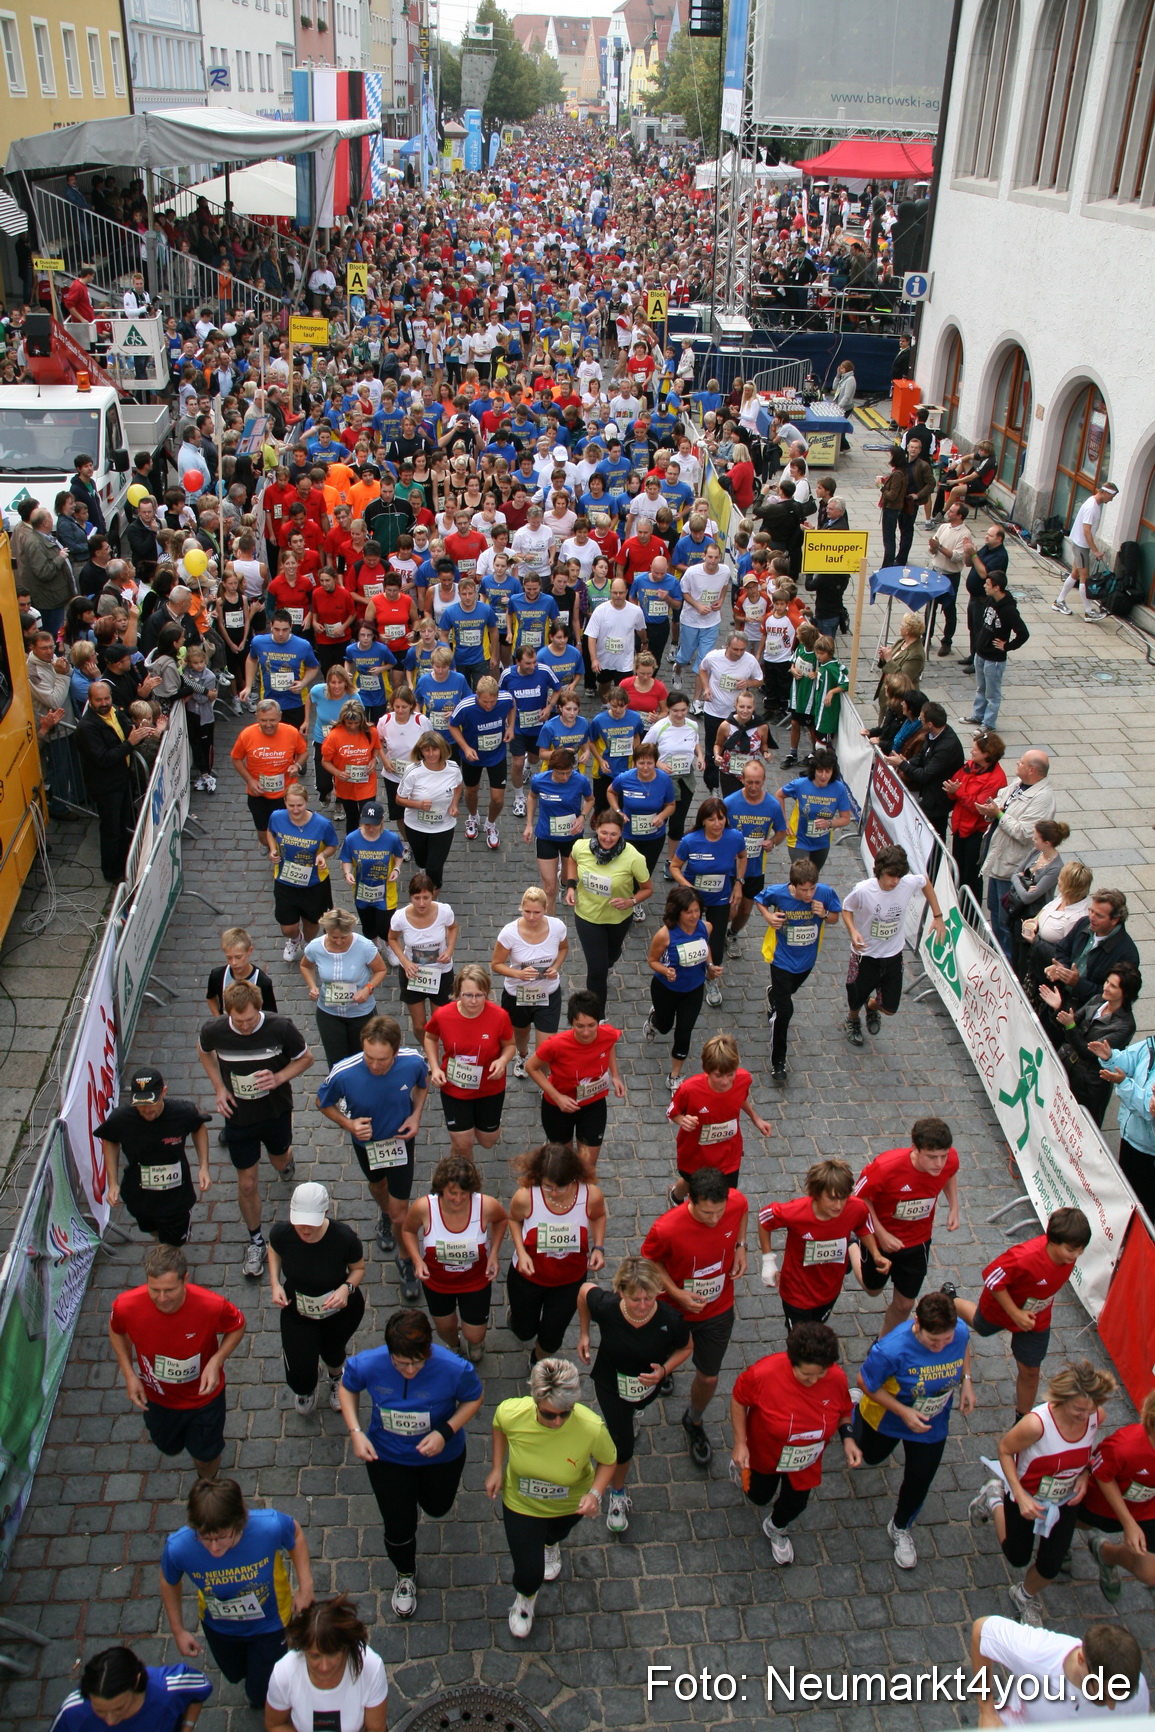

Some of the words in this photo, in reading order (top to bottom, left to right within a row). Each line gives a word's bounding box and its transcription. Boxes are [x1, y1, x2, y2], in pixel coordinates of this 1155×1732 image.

[351, 272, 363, 288] A
[652, 300, 664, 315] A
[292, 323, 326, 332] Schnupper-
[808, 542, 862, 554] Schnupper-
[825, 554, 844, 564] lauf
[266, 780, 283, 788] 5213
[282, 838, 311, 848] STADTLAUF
[284, 834, 318, 845] NEUMARKTER
[290, 870, 308, 880] 5220
[590, 883, 608, 892] 5180
[796, 932, 816, 940] 5020
[880, 928, 898, 936] 5010
[688, 949, 706, 960] 5242
[417, 976, 437, 986] 5011
[990, 967, 1013, 1010] UNS
[334, 992, 354, 1000] 5222
[526, 992, 546, 1001] 5158
[961, 1007, 996, 1090] BESSER
[456, 1063, 472, 1072] Monika
[455, 1070, 478, 1083] 5093
[711, 1129, 734, 1138] 5036
[378, 1147, 404, 1159] 5145
[152, 1166, 166, 1174] Ralph
[153, 1172, 179, 1183] 5140
[906, 1204, 930, 1215] 5033
[550, 1234, 577, 1244] 5084
[448, 1250, 476, 1258] 5085
[816, 1249, 843, 1258] 5035
[696, 1284, 721, 1296] 5090
[168, 1366, 196, 1376] 5052
[920, 1358, 964, 1374] NEUMARKTER
[919, 1370, 958, 1381] STADTLAUF
[396, 1420, 426, 1430] 5029
[792, 1451, 818, 1465] 5071
[532, 1486, 564, 1494] 5026
[205, 1557, 270, 1580] NEUMARKTER
[204, 1570, 259, 1586] STADTLAUF
[222, 1603, 257, 1615] 5114
